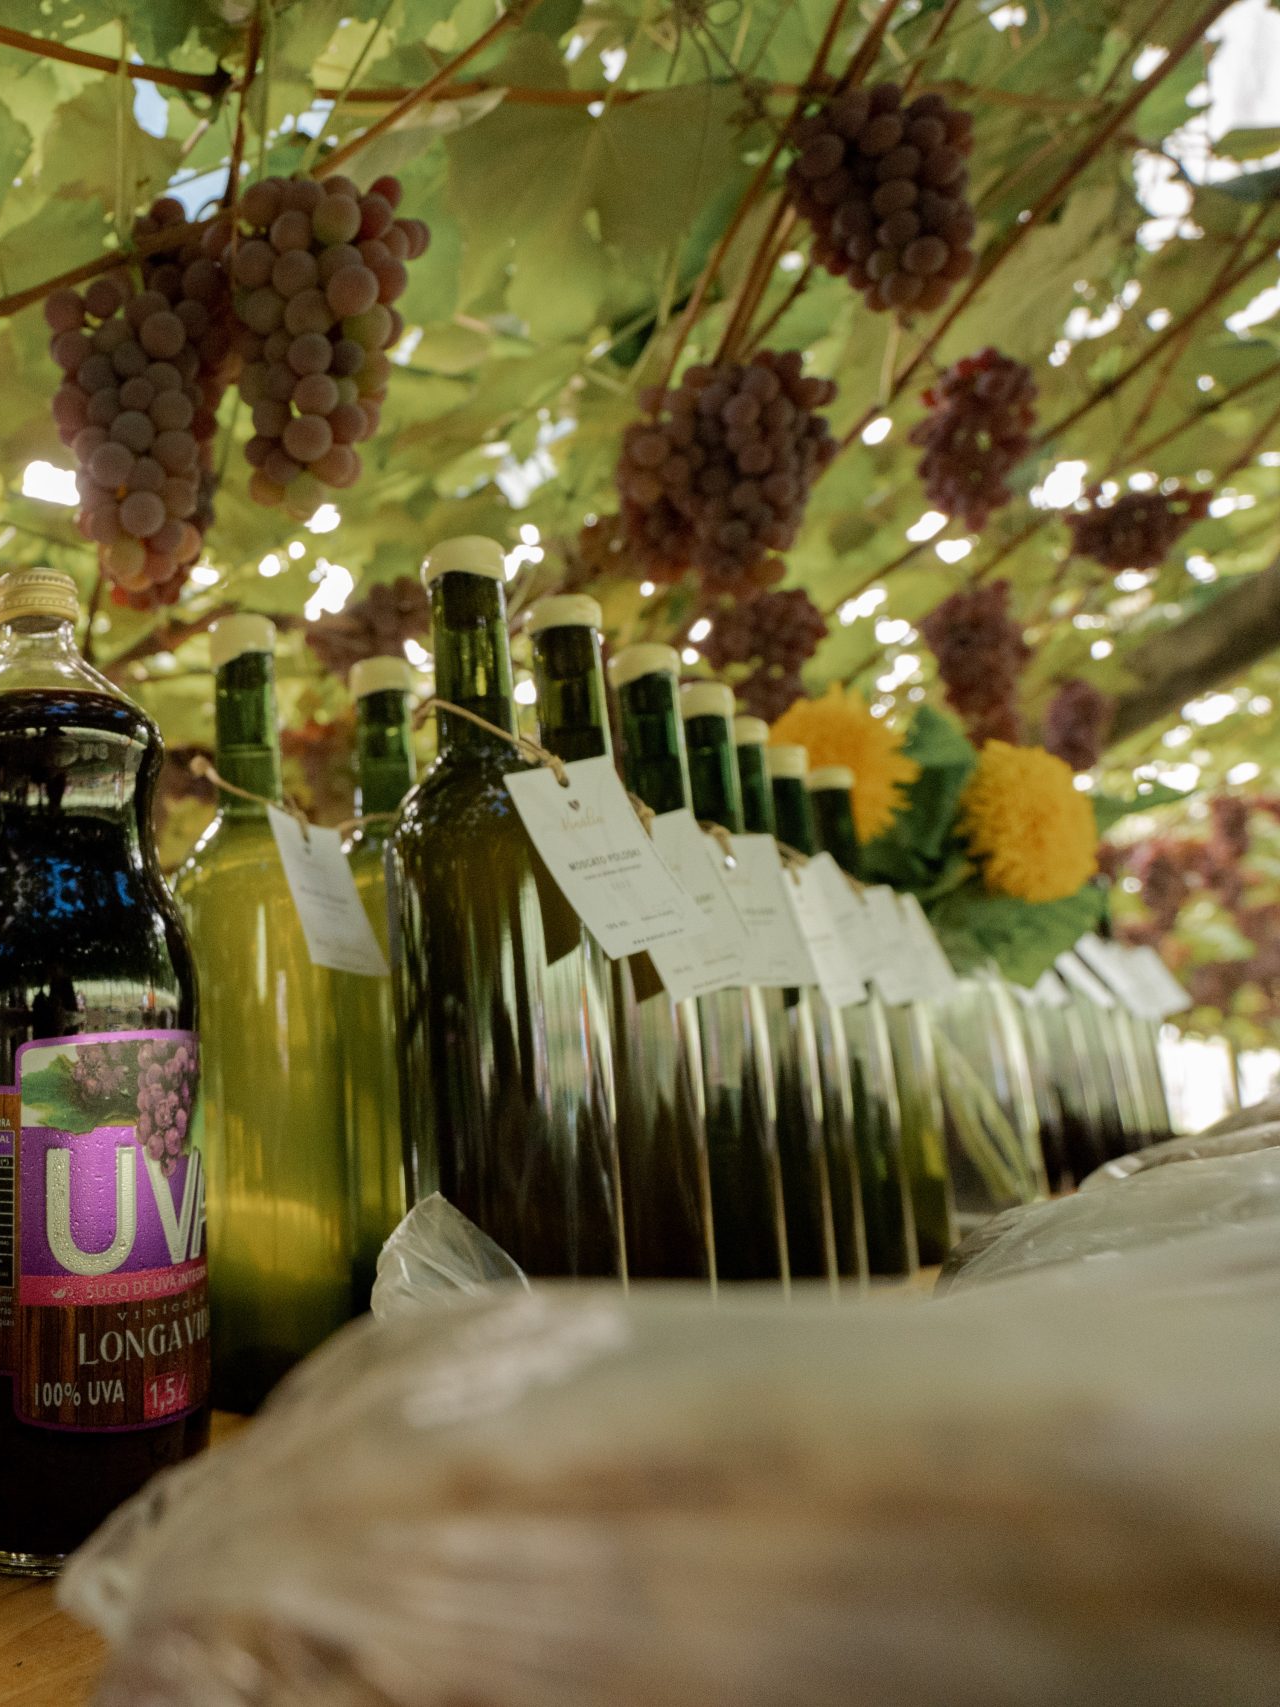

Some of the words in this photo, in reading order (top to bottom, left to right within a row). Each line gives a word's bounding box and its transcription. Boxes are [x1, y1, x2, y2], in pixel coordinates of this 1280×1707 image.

[86, 1282, 129, 1299] SUCO
[133, 1279, 150, 1296] DE
[153, 1273, 177, 1292] UVA
[178, 1264, 207, 1286] INTEGR
[78, 1319, 183, 1366] LONGA
[184, 1307, 209, 1345] VID
[34, 1380, 81, 1407] 100%
[87, 1379, 125, 1406] UVA
